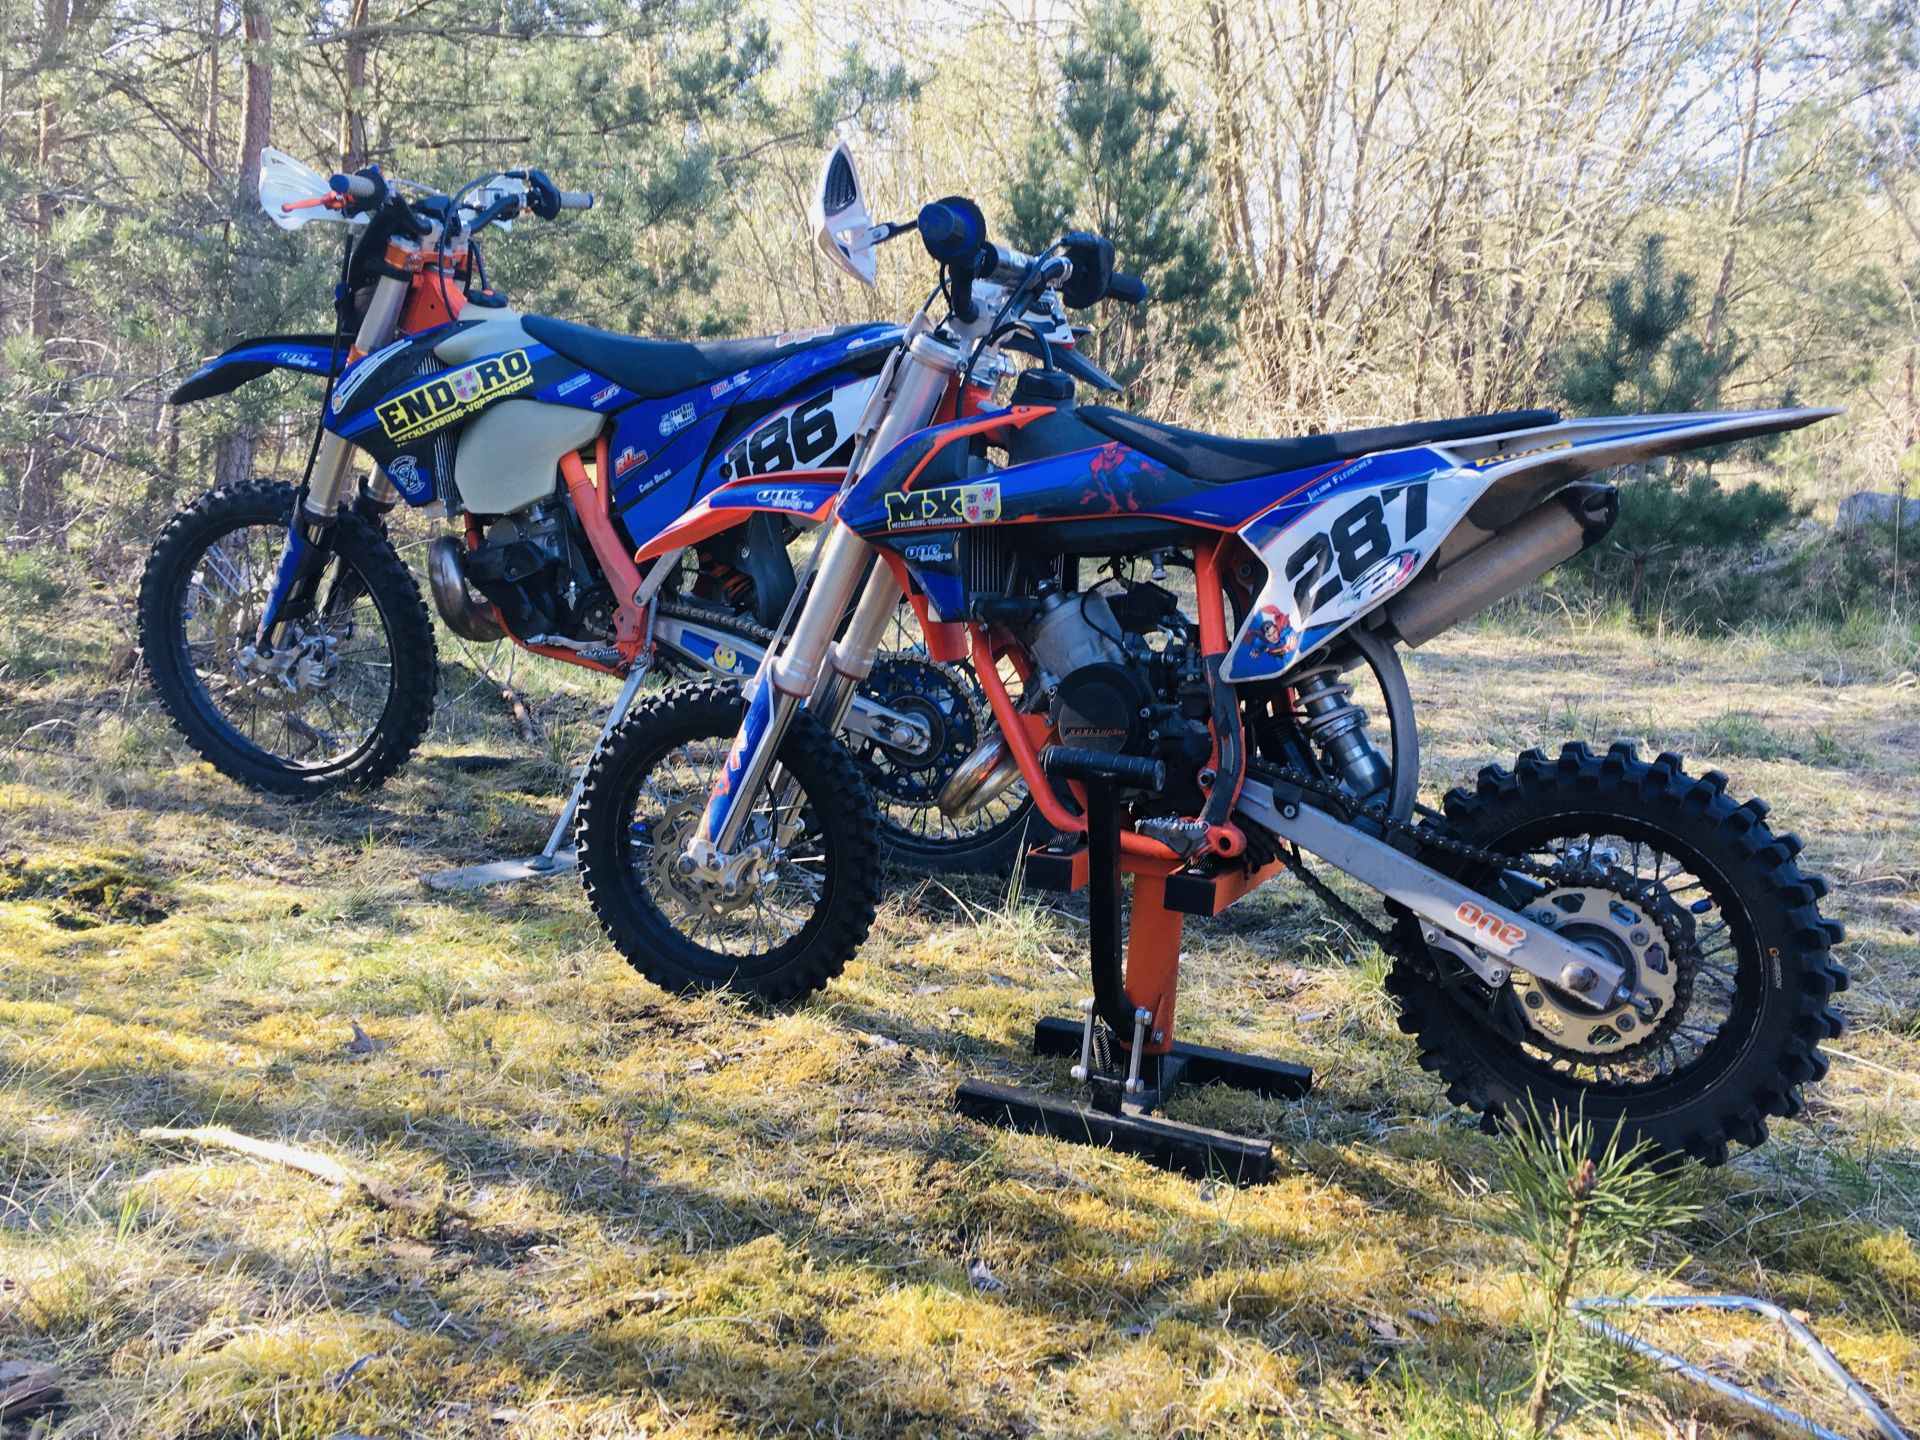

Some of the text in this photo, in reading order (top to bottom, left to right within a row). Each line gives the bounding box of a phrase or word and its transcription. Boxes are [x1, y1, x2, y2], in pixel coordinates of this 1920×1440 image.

[727, 387, 838, 479] 186
[1285, 469, 1437, 623] 287
[1456, 902, 1526, 946] one
